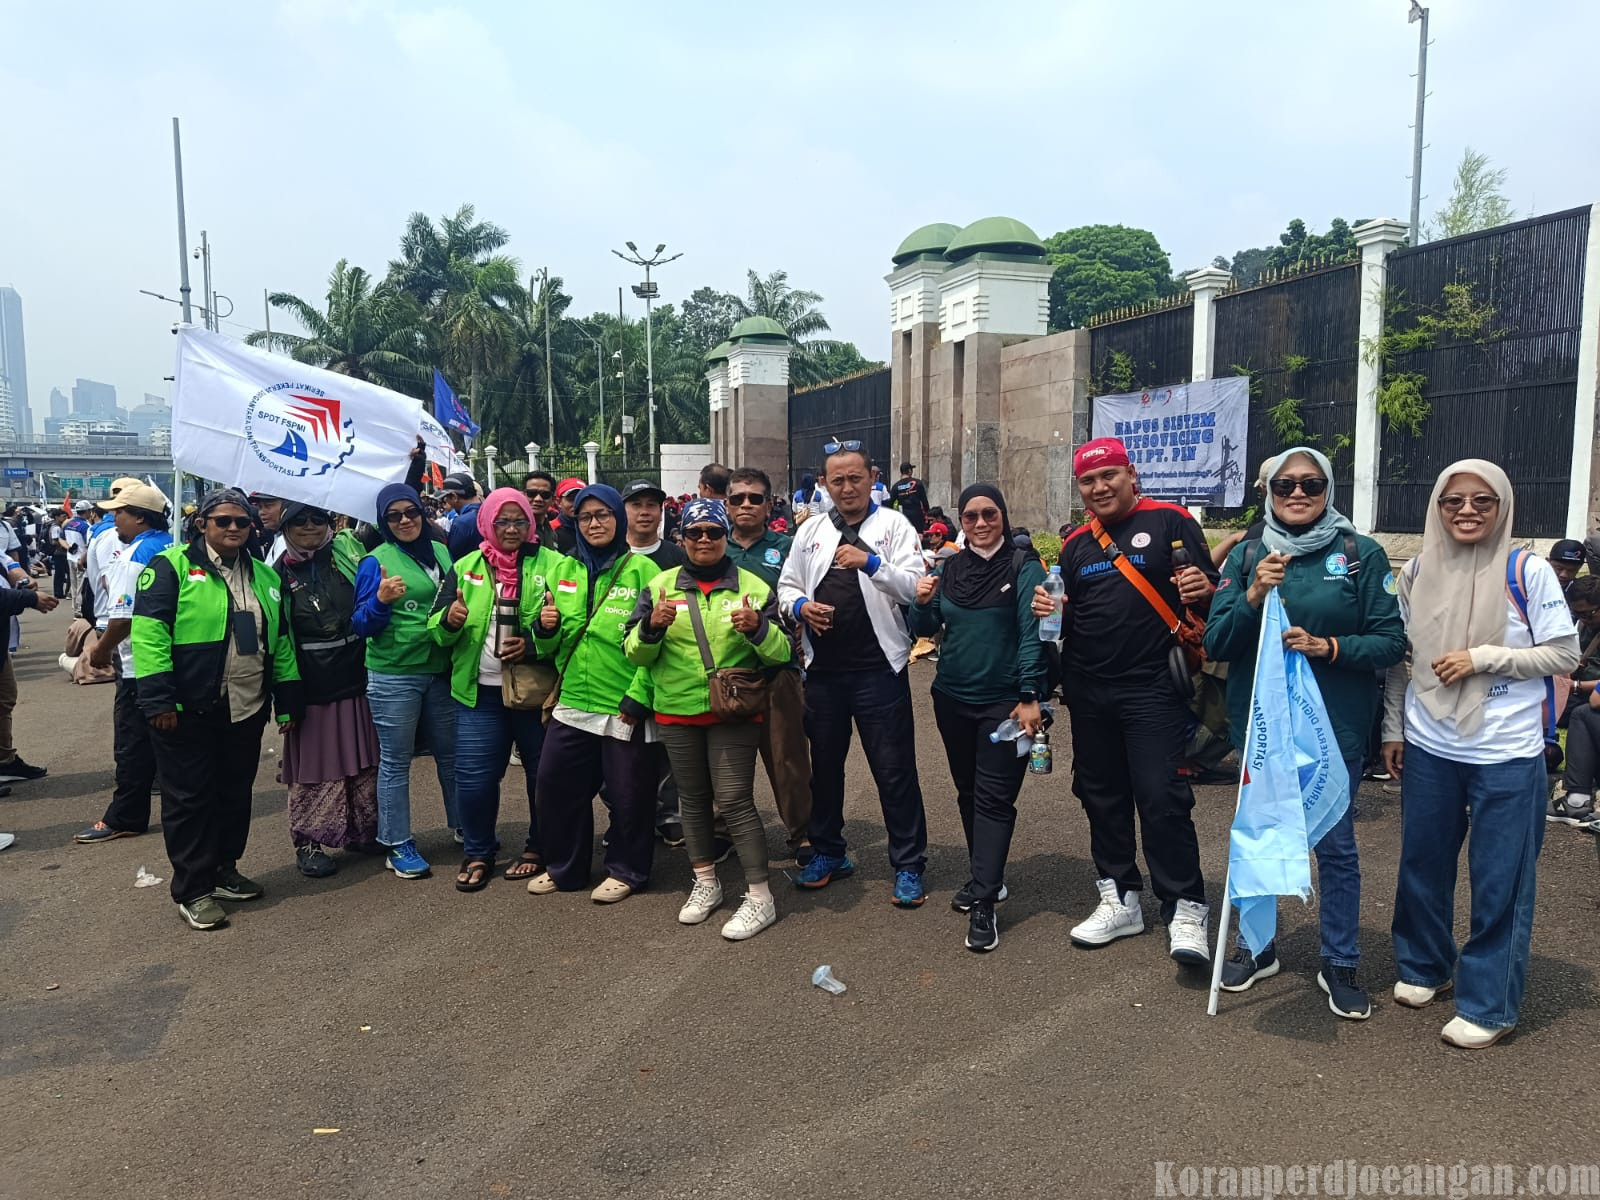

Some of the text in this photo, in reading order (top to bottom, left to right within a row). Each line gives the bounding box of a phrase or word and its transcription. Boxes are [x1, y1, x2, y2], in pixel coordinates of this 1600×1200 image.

[257, 410, 307, 434] SPDT FSPMI
[1163, 412, 1216, 431] SISTEM
[249, 439, 295, 477] TRANSPORTASI
[1145, 447, 1169, 464] PT.
[1081, 560, 1113, 575] GARDA
[1127, 554, 1147, 565] TAL
[607, 586, 638, 601] goje
[604, 606, 632, 618] tokop
[1252, 695, 1268, 771] RANSPORTASI
